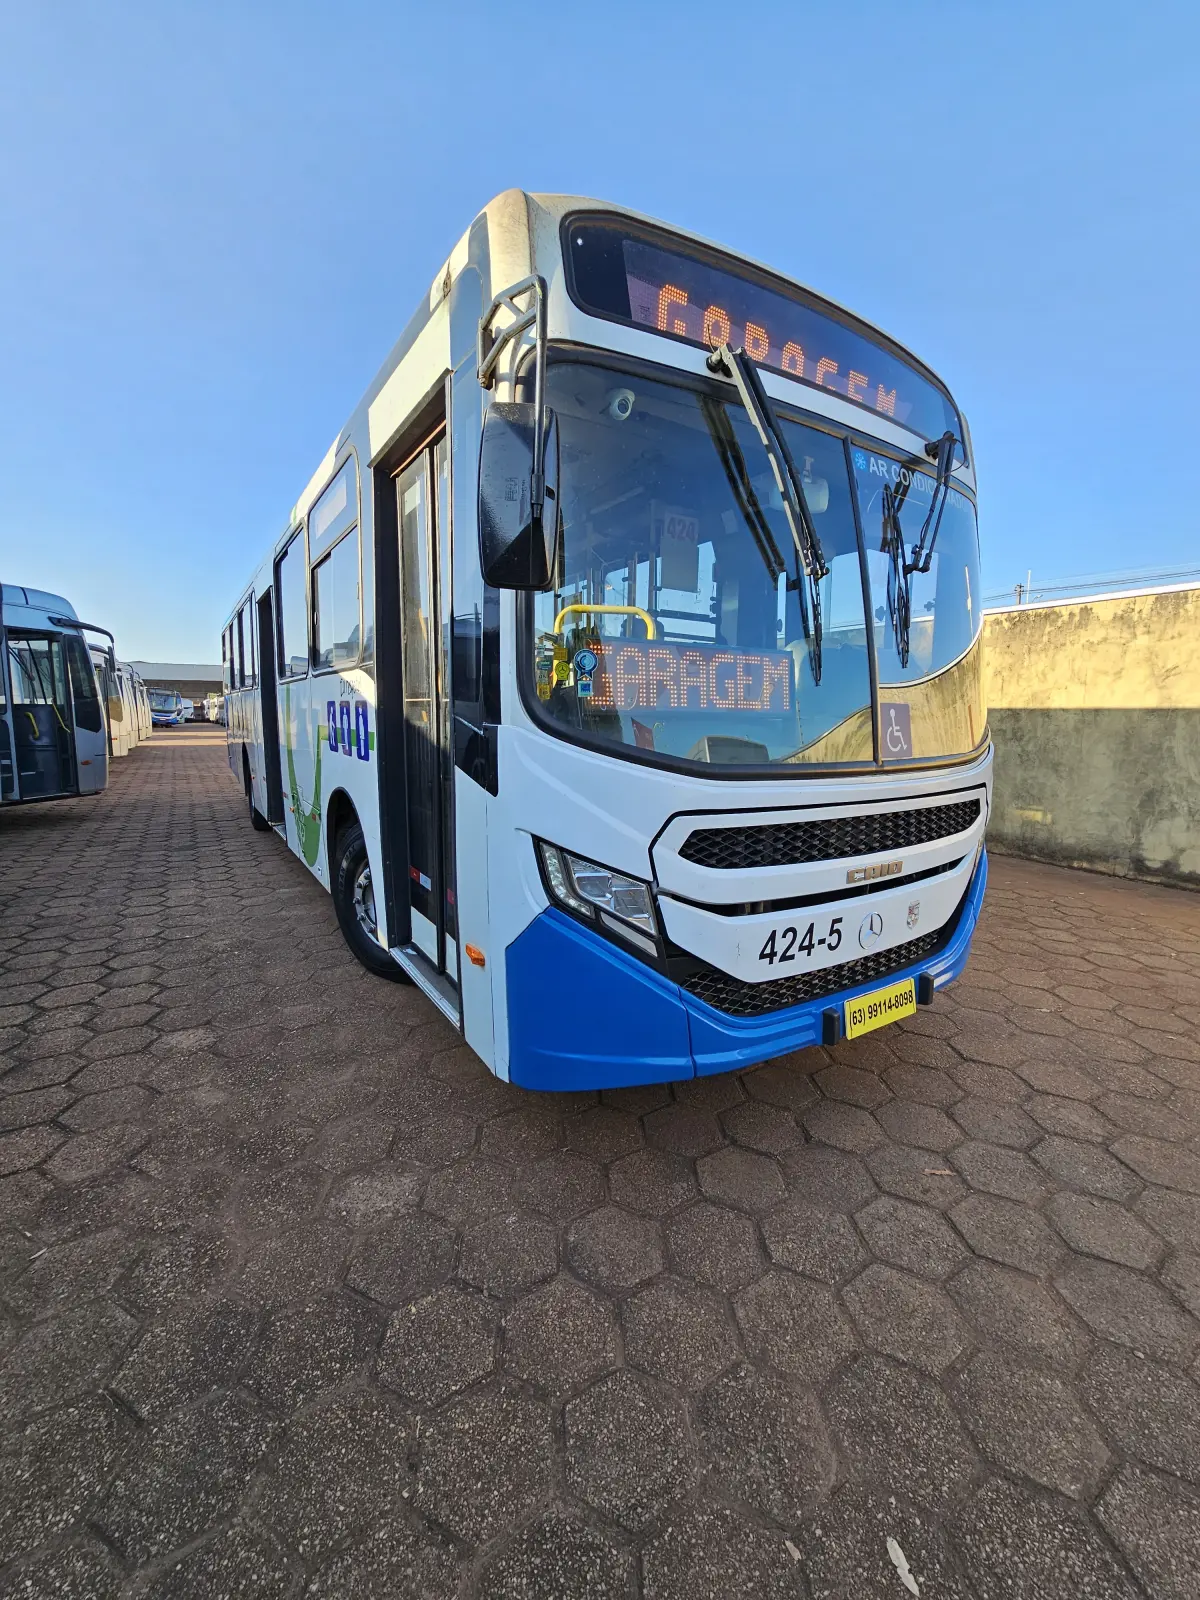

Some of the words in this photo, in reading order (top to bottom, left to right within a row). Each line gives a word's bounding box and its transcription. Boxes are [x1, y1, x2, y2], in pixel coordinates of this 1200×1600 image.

[869, 457, 889, 480] AR
[583, 643, 790, 710] GARAGEM
[846, 860, 903, 884] CAIO
[758, 917, 843, 965] 424-5
[850, 1007, 866, 1027] (63)
[867, 989, 914, 1020] 99114-8098
